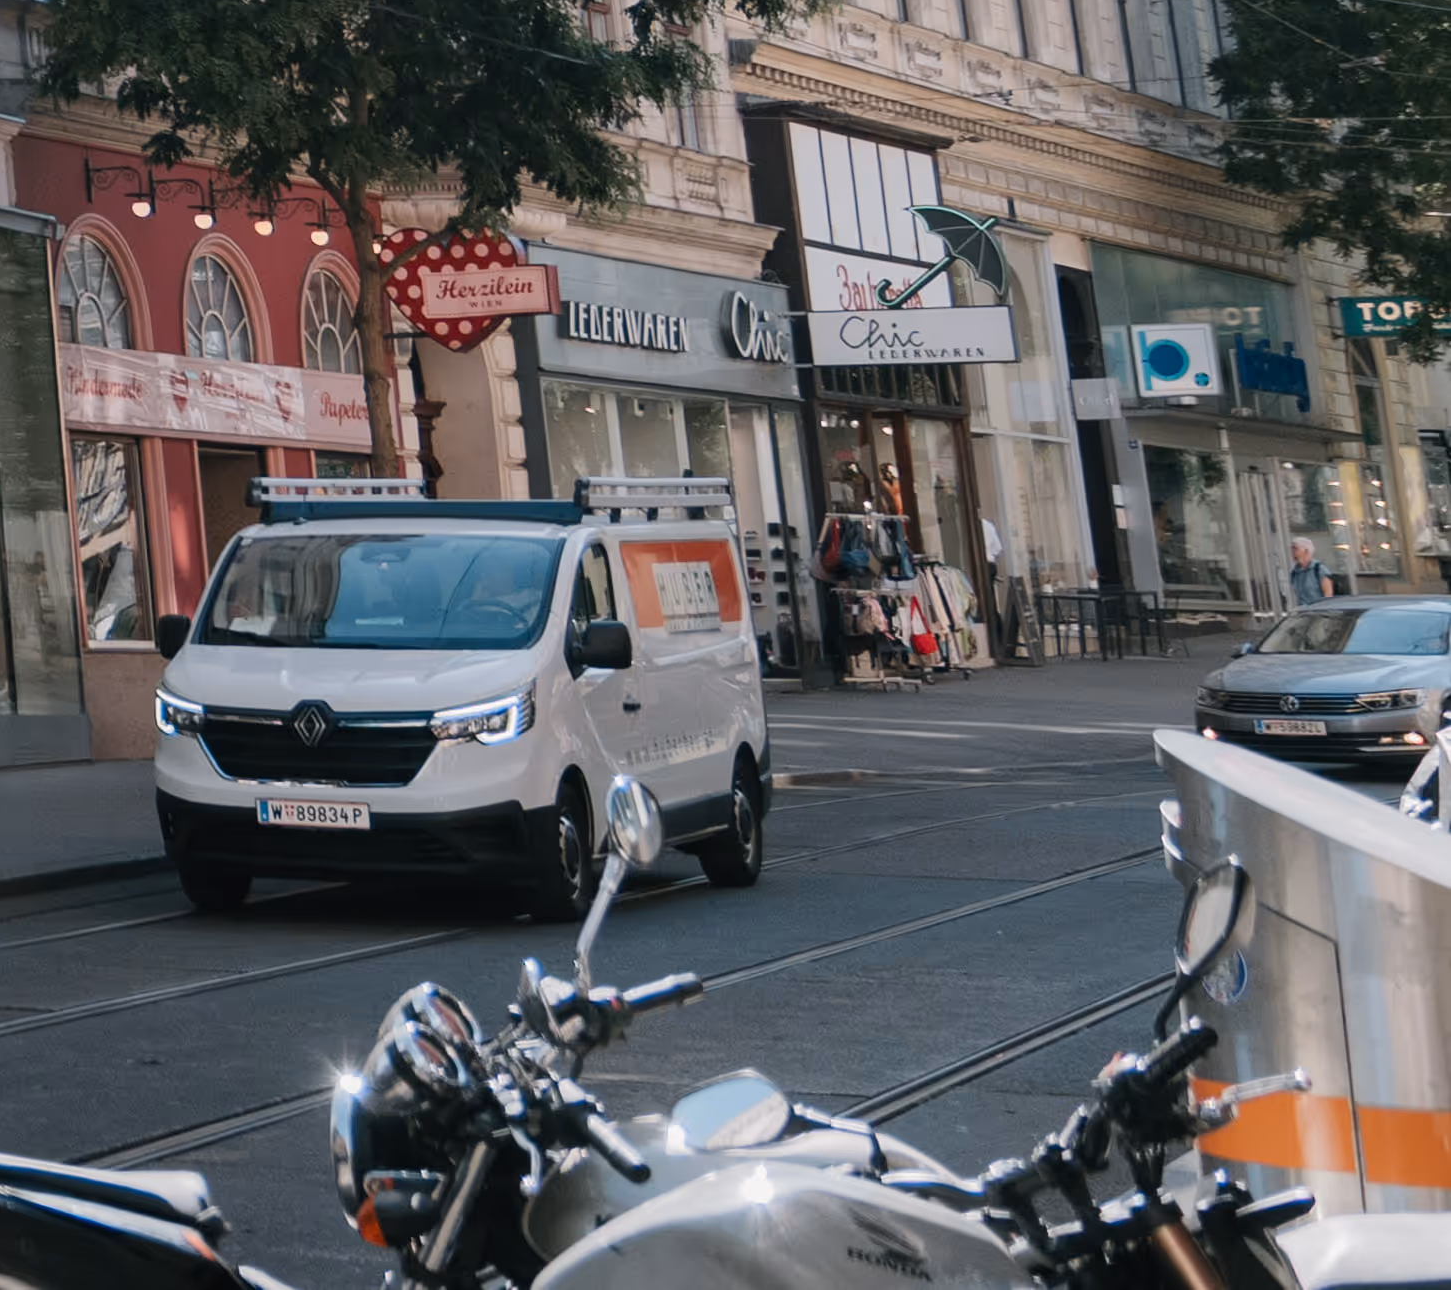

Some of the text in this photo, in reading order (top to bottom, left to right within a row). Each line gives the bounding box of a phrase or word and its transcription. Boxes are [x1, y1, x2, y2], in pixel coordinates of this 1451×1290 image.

[435, 275, 535, 300] Herzilein
[468, 299, 504, 310] WIEN
[568, 290, 790, 364] LEDERWAREN Chic
[839, 315, 925, 349] Chic
[868, 346, 986, 359] LEDERWAREN
[320, 391, 371, 427] Papeter
[271, 804, 283, 821] W
[847, 1246, 934, 1283] HONDA
